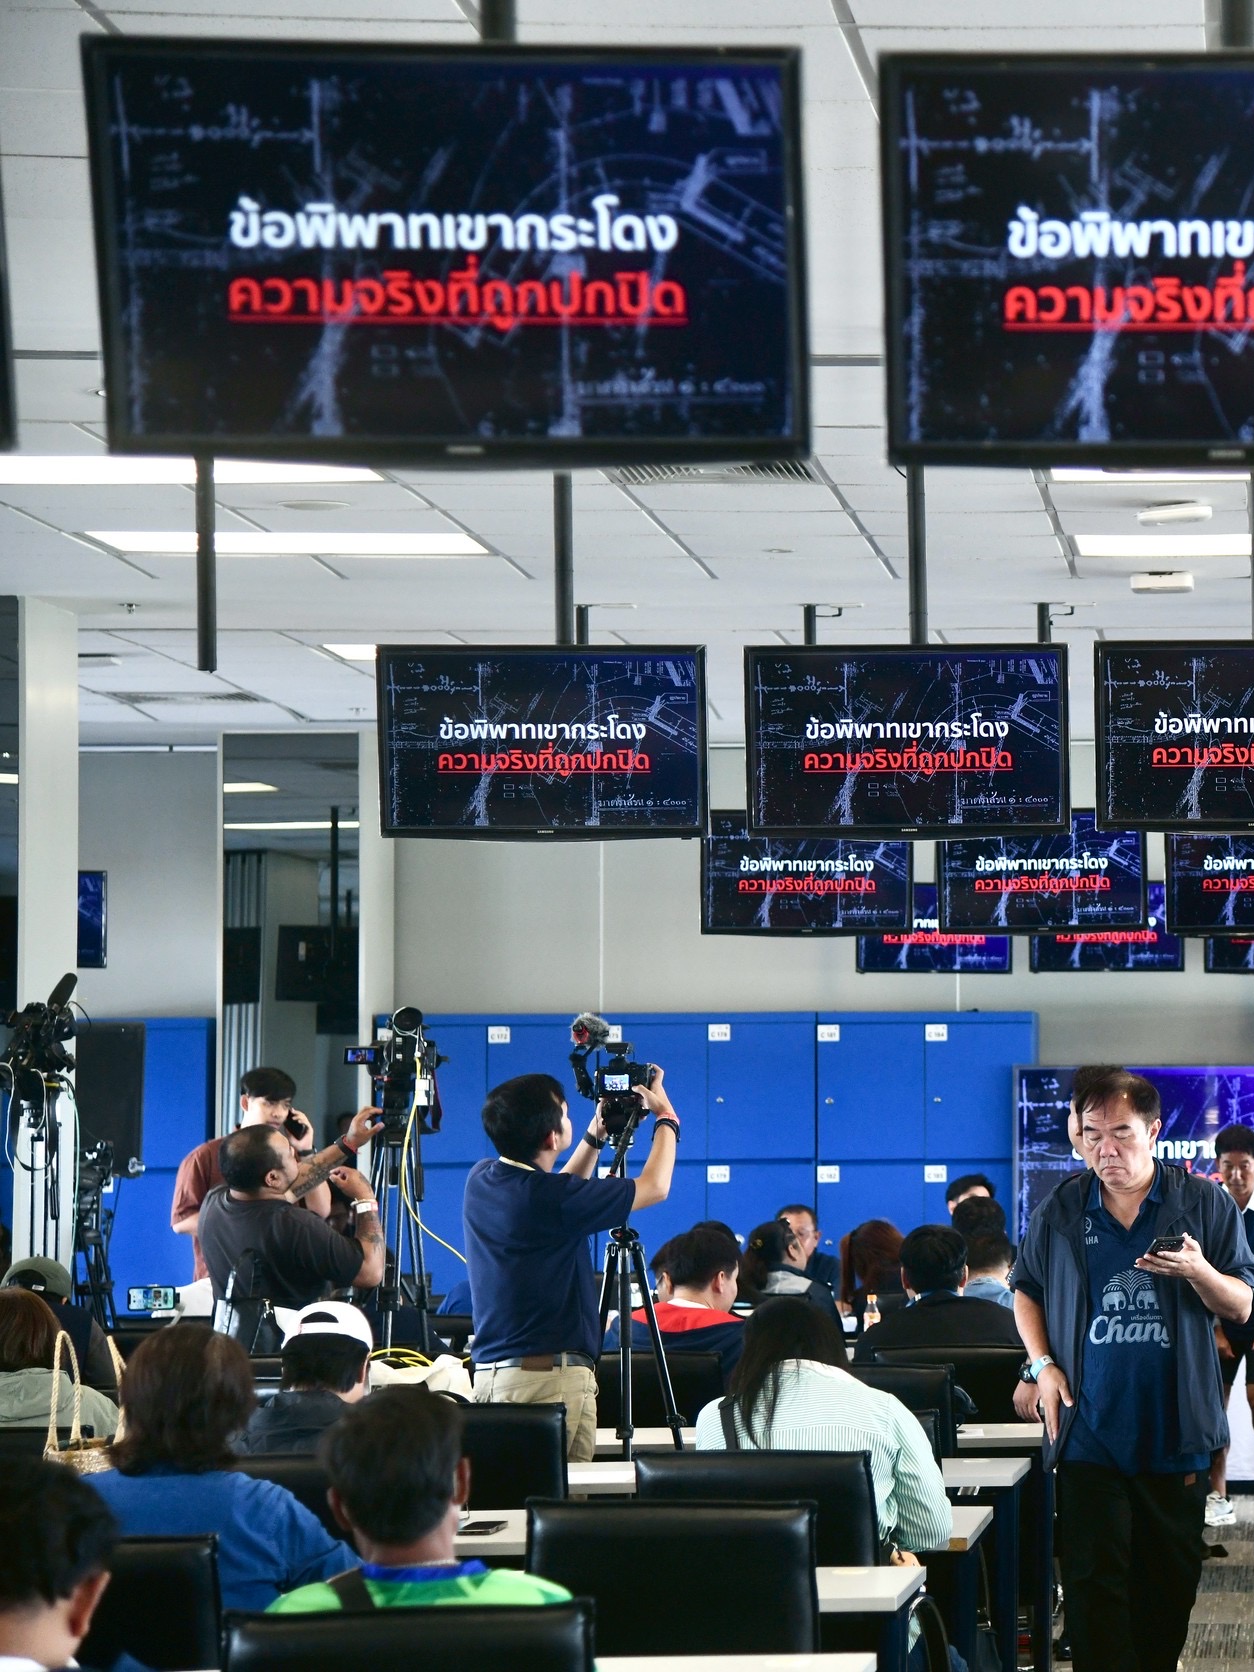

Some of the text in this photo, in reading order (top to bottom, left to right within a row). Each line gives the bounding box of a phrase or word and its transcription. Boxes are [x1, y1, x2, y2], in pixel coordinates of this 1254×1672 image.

[230, 195, 679, 252] ข้อพิพาทเขากระโดง
[229, 255, 687, 331] ความจริงที่ถูกปกปิด
[439, 714, 647, 740] ข้อพิพาทเขากระโดง
[806, 713, 1010, 740] ข้อพิพาทเขากระโดง
[437, 742, 651, 777] ความจริงที่ถูกปกปิด
[804, 741, 1013, 776] ความจริงที่ถูกปกปิด
[739, 854, 874, 873] ข้อพิพาทเขากระโดง
[975, 852, 1109, 872] ข้อพิพาทเขากระโดง
[738, 874, 876, 896] ความจริงที่ถูกปกปิด
[974, 872, 1111, 894] ความจริงที่ถูกปกปิด
